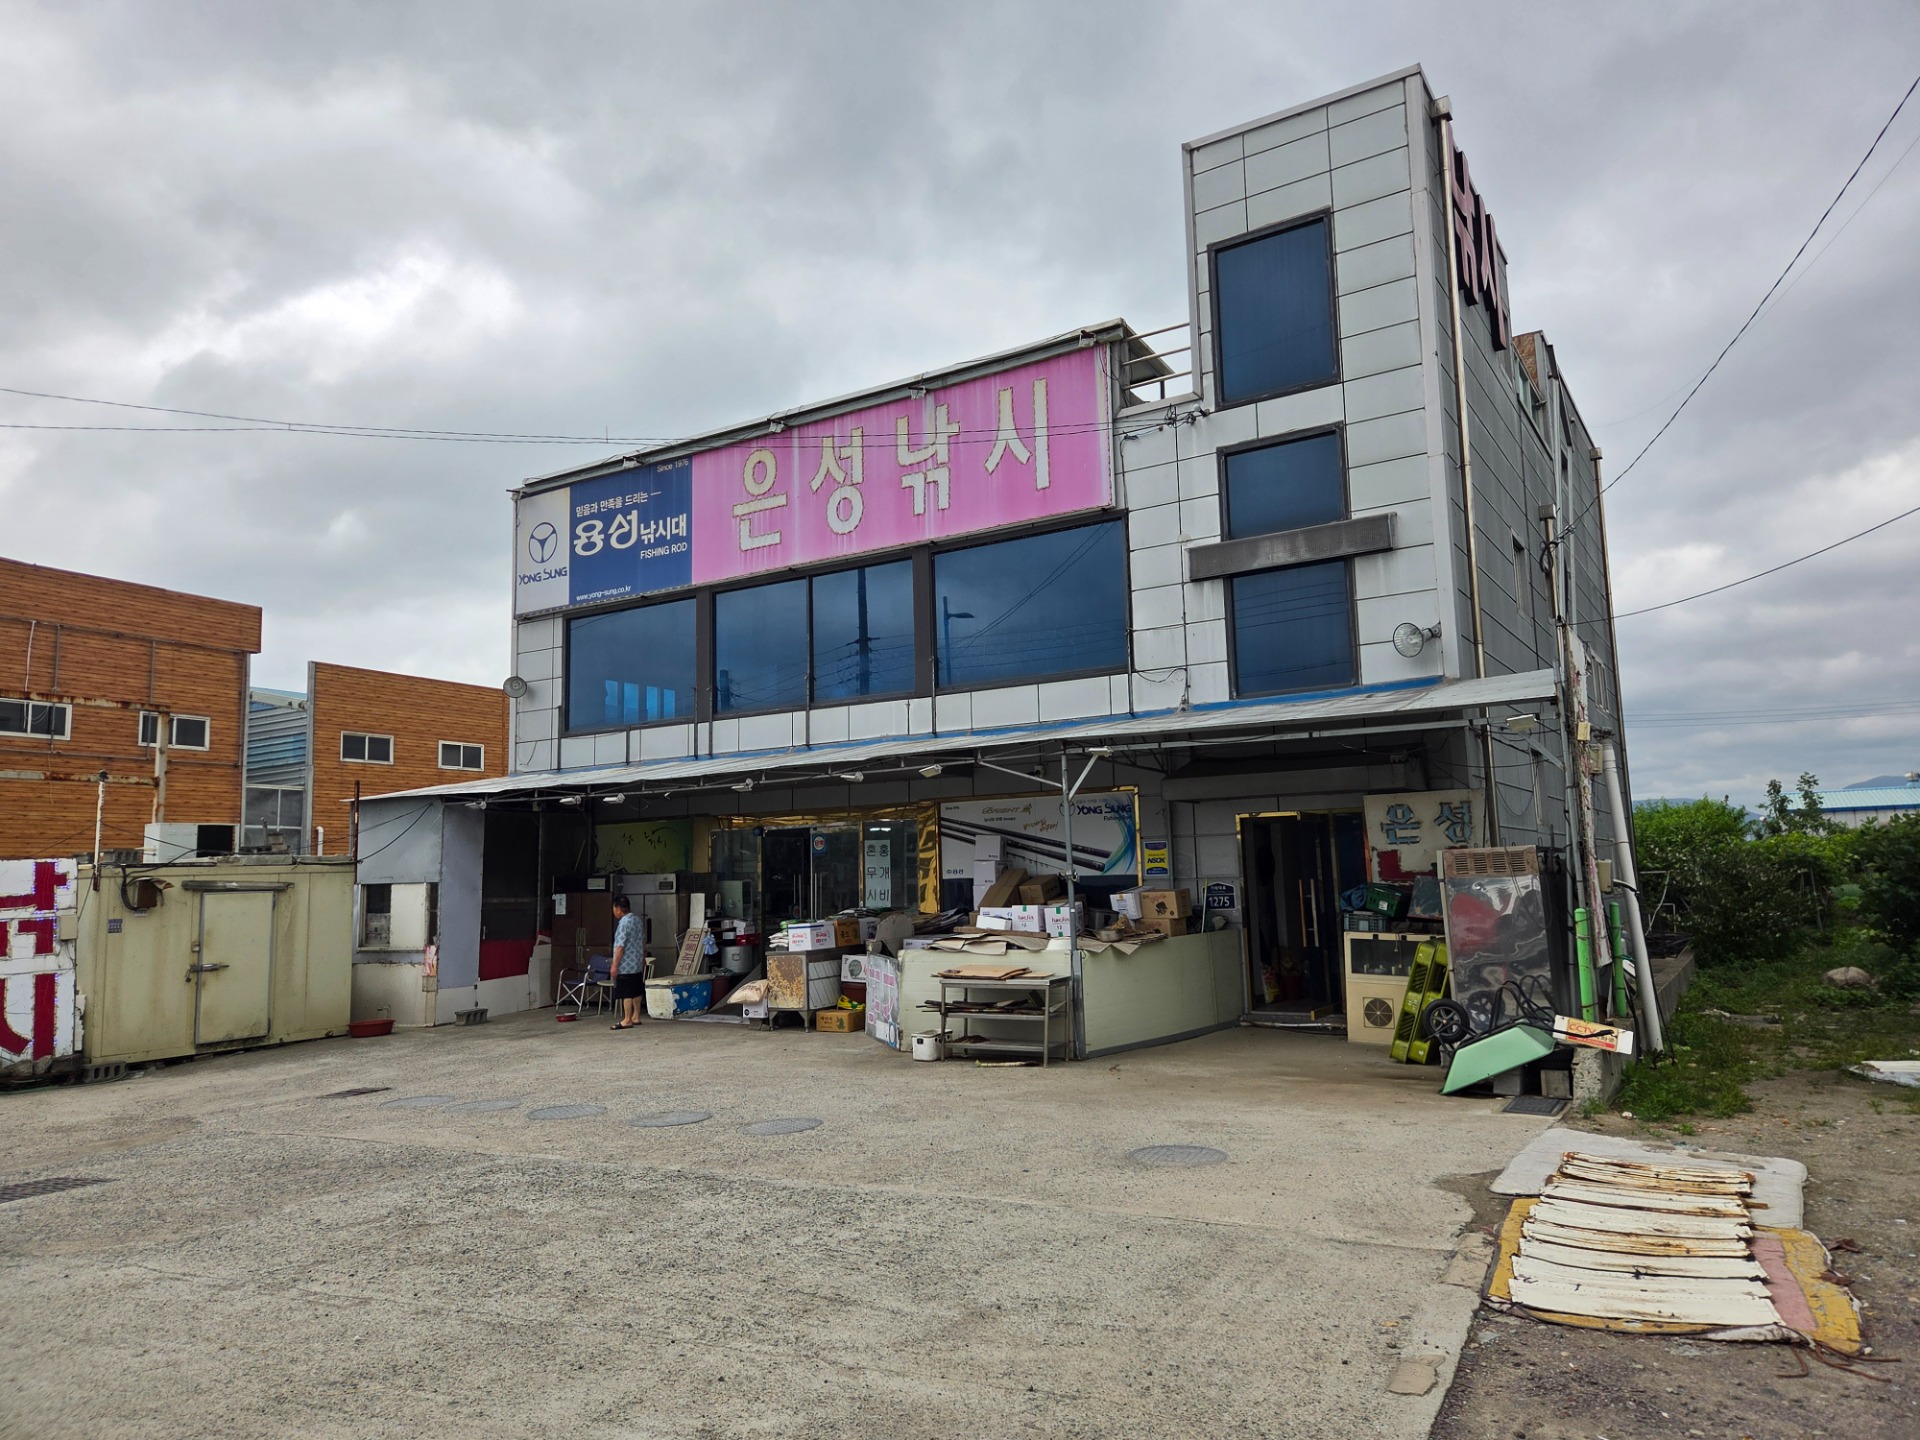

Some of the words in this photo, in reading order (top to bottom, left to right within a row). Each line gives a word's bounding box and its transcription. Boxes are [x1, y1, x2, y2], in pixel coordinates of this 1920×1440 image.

[657, 464, 673, 473] Since
[576, 502, 598, 518] 믿음과
[600, 496, 623, 512] 만족을
[624, 492, 648, 506] 드리는
[574, 509, 638, 556] 용성
[640, 545, 670, 560] FISHING
[671, 541, 688, 554] ROD
[518, 572, 542, 586] YONG
[575, 584, 632, 602] www.yong-sung.co.kr
[1077, 804, 1103, 815] YONG
[1208, 896, 1230, 907] 1275
[1568, 1023, 1596, 1035] CCTV
